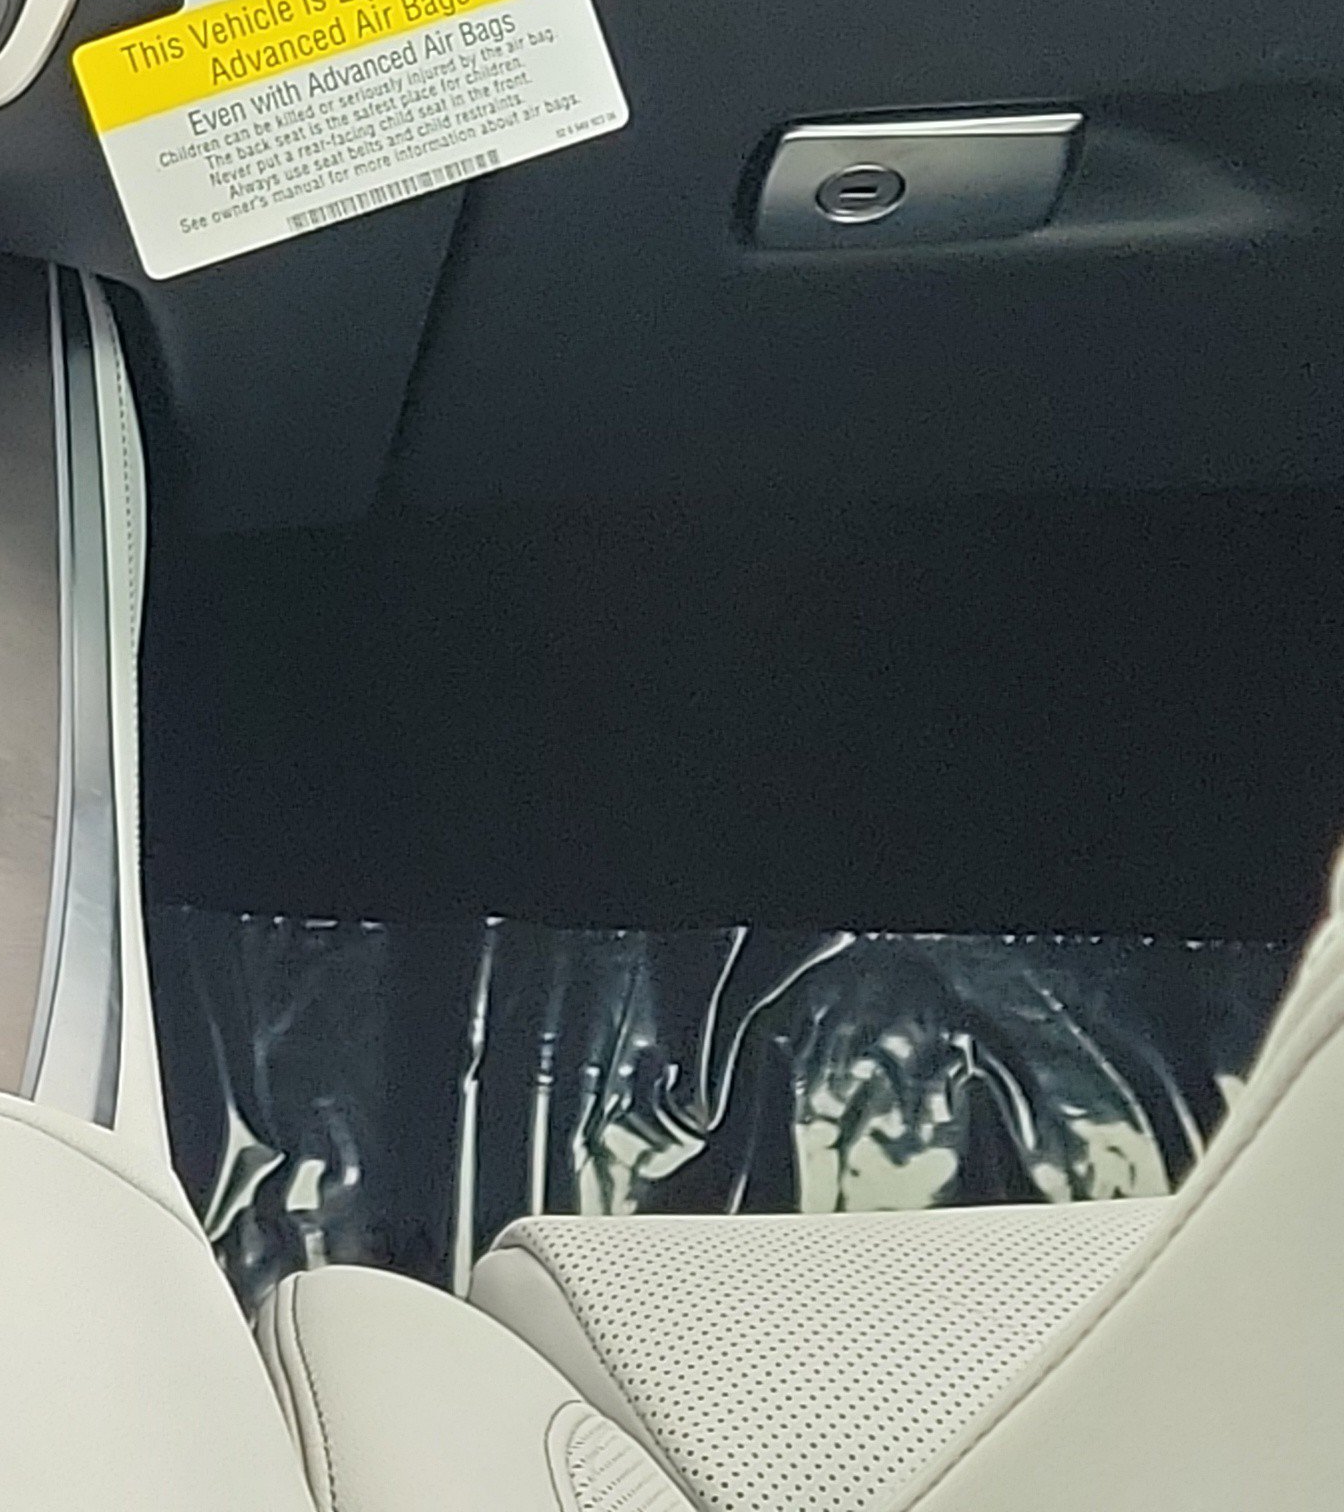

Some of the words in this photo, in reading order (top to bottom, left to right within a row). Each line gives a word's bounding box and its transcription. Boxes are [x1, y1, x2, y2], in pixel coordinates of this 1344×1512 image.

[119, 34, 185, 73] This
[187, 102, 247, 136] Even
[249, 80, 302, 115] with
[308, 40, 418, 98] Advanced
[424, 30, 453, 60] Air
[458, 14, 516, 47] Bags
[212, 16, 346, 86] Advanced
[357, 4, 391, 39] Air
[159, 138, 221, 168] Children
[224, 128, 251, 146] can
[253, 122, 271, 136] be
[275, 104, 315, 129] killed
[338, 78, 402, 108] seriously
[407, 59, 457, 85] injured
[480, 46, 502, 61] the
[204, 152, 233, 170] The
[235, 138, 271, 160] back
[274, 127, 307, 147] seat
[325, 114, 349, 130] the
[353, 97, 397, 122] safest
[399, 85, 438, 109] place
[440, 77, 460, 93] for
[209, 163, 251, 187] Never
[256, 153, 282, 175] put
[379, 109, 415, 131] child
[418, 98, 447, 118] seat
[467, 86, 490, 102] the
[180, 216, 208, 234] See
[271, 174, 325, 203] manual
[328, 169, 349, 185] for
[353, 155, 391, 176] more
[394, 127, 476, 162] information
[481, 111, 519, 135] about
[229, 173, 281, 200] Always
[284, 164, 310, 181] use
[313, 151, 345, 171] seat
[347, 140, 384, 160] belts
[386, 127, 414, 147] and
[417, 114, 452, 137] child
